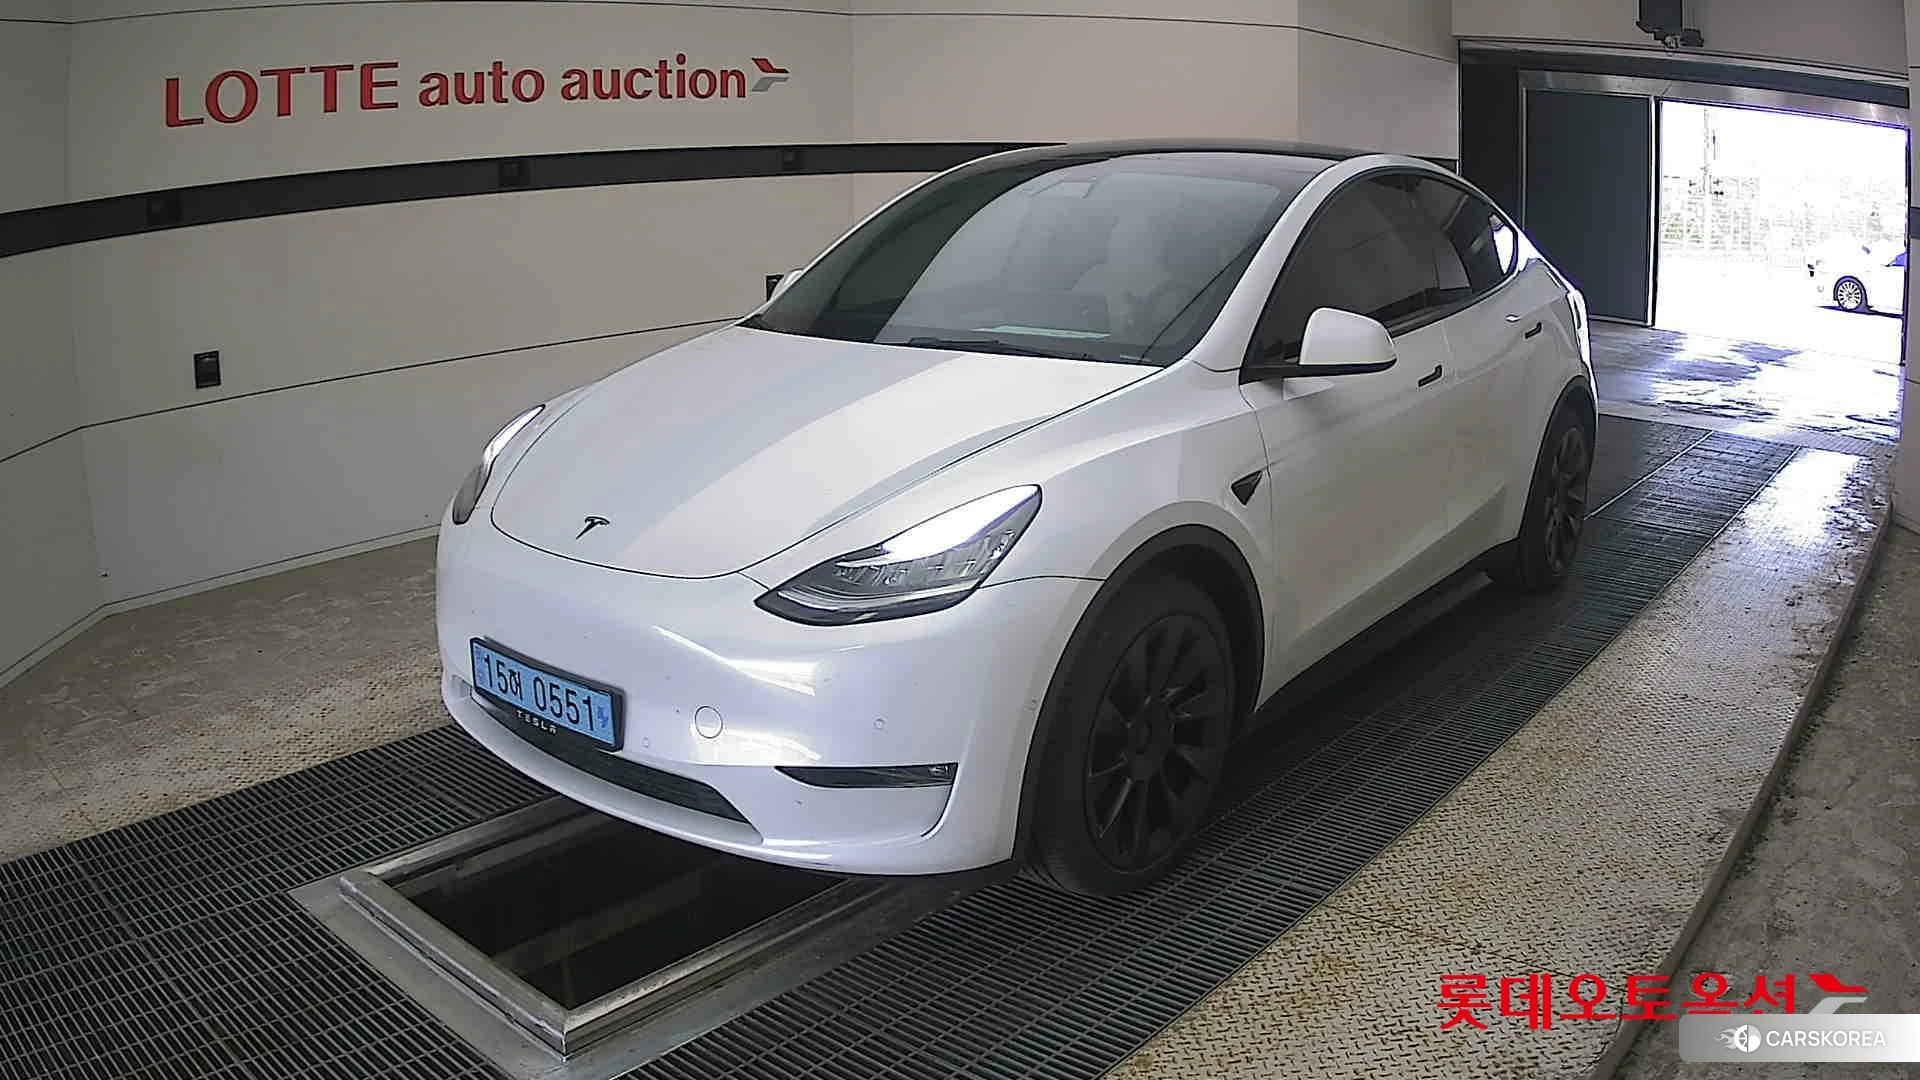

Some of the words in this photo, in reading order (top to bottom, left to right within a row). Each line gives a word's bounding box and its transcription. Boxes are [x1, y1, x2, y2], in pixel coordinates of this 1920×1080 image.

[164, 60, 400, 128] LOTTE
[418, 61, 546, 108] auto
[560, 53, 747, 101] auction
[515, 709, 558, 735] TESLA
[532, 676, 595, 732] 0551
